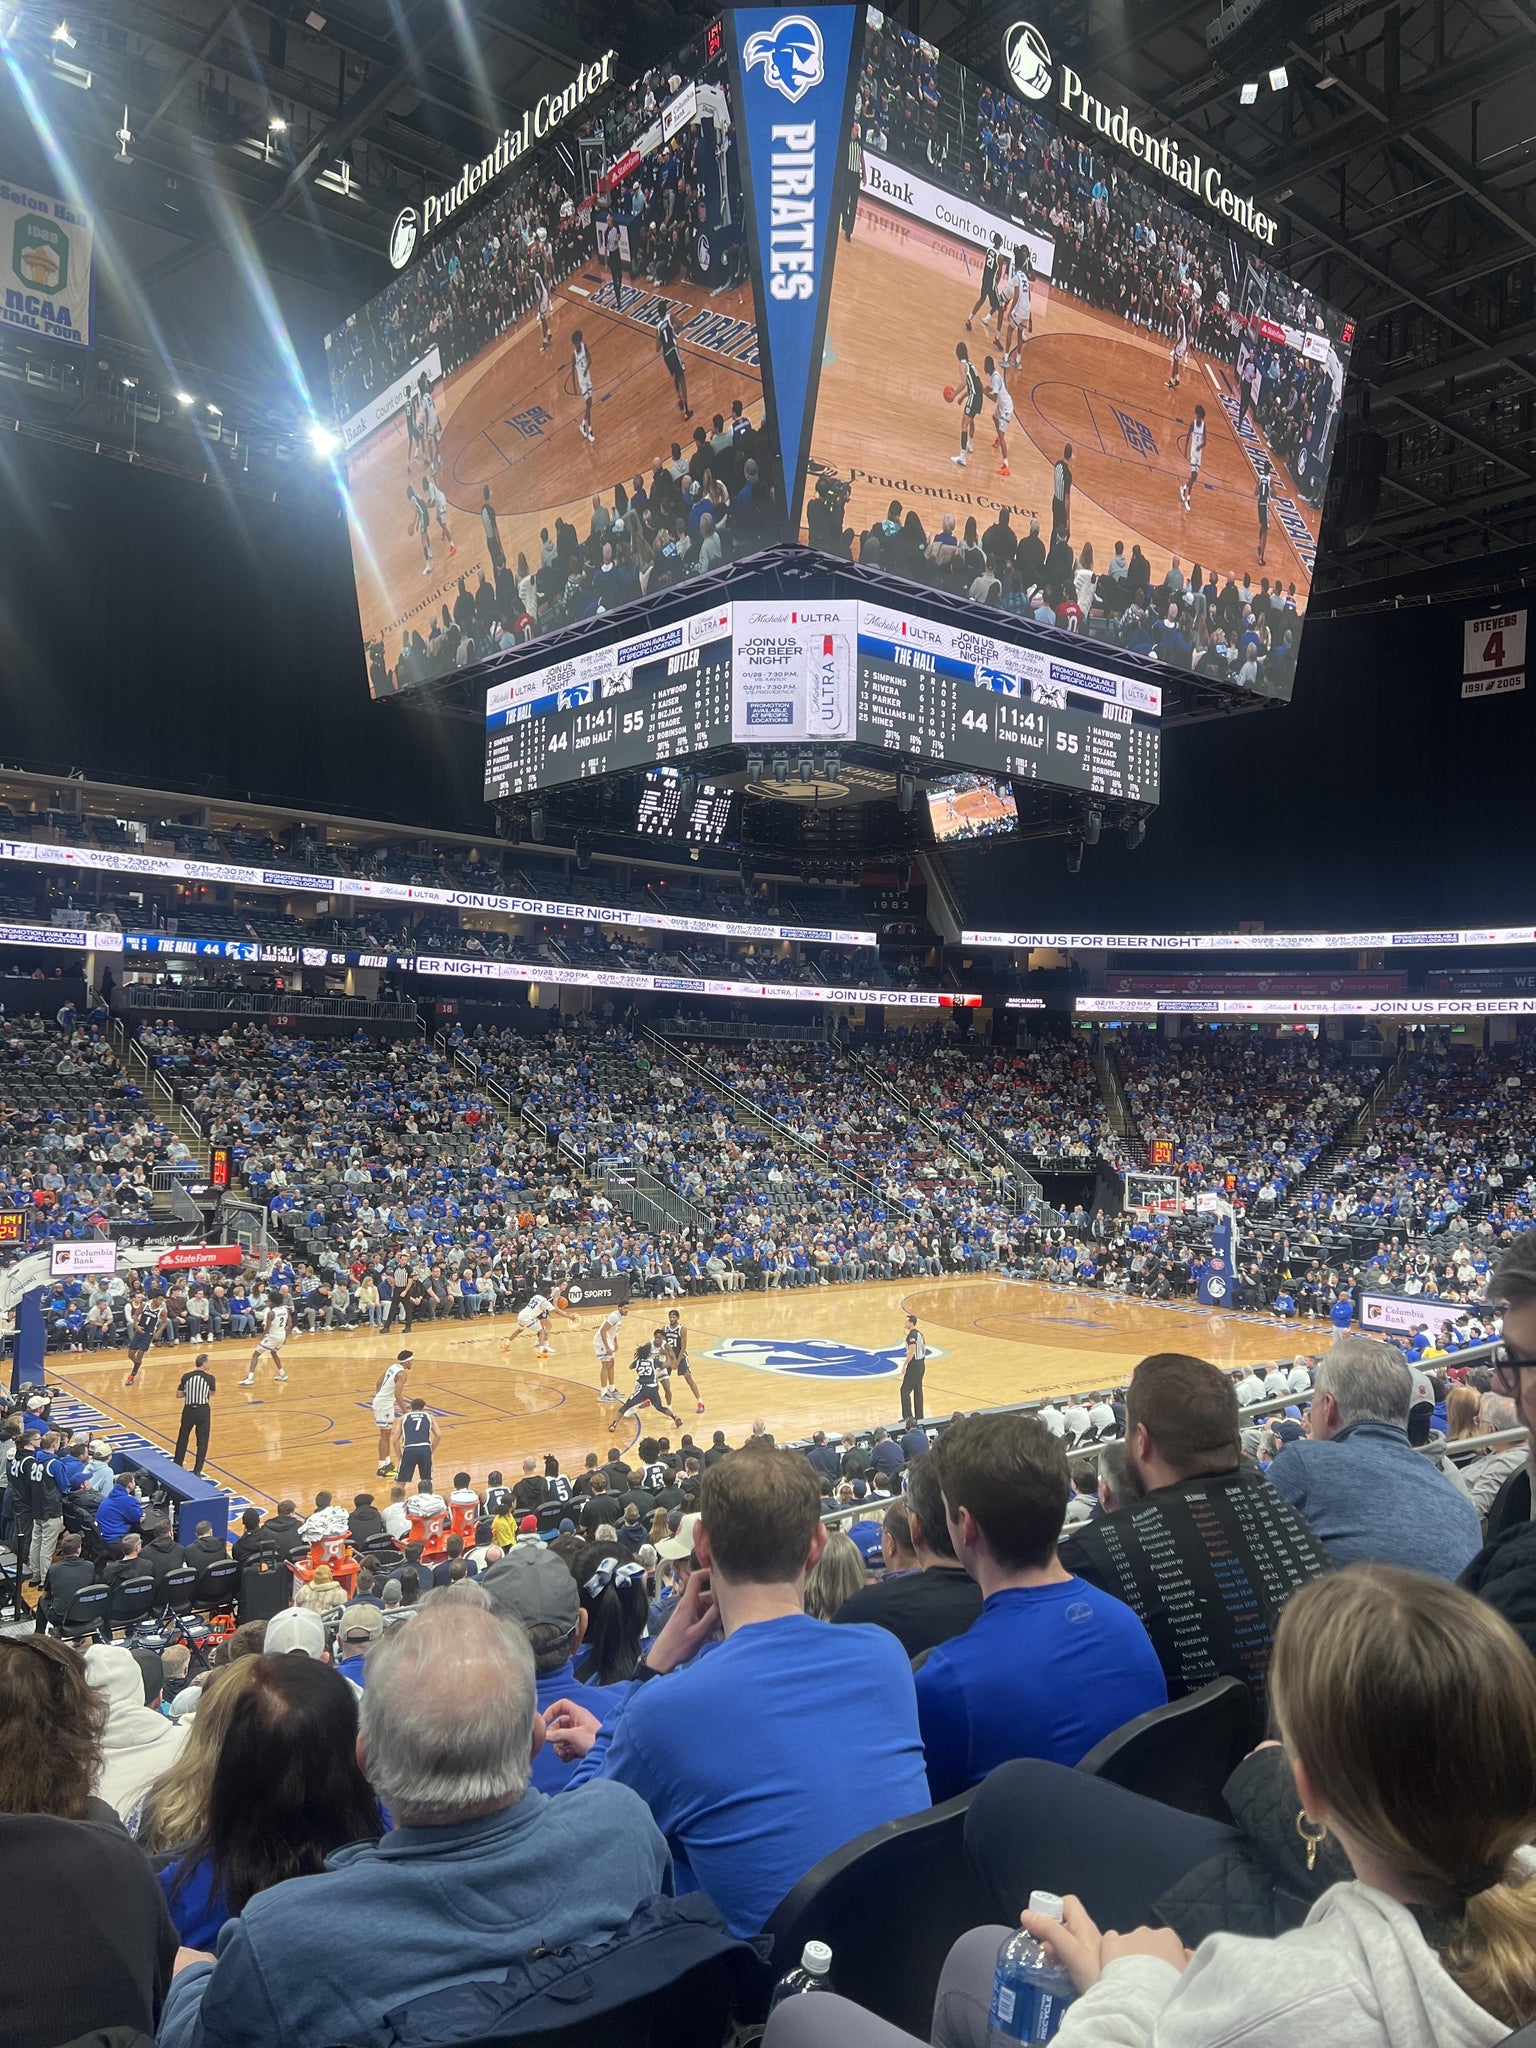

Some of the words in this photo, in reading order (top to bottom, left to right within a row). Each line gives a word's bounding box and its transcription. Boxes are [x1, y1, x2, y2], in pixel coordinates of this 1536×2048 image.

[423, 110, 529, 236] Prudential
[534, 49, 613, 138] Center
[1061, 65, 1200, 196] Prudential
[1206, 168, 1278, 246] Center
[870, 166, 914, 205] Bank
[935, 204, 971, 232] Count
[973, 225, 986, 239] on
[770, 120, 816, 300] PIRATES
[6, 288, 72, 327] NCAA
[44, 321, 82, 342] FOUR
[525, 406, 554, 425] BIG
[512, 414, 544, 438] EAST
[1118, 411, 1147, 459] EAST
[1134, 422, 1160, 455] BIG
[851, 468, 972, 504] Prudential
[380, 589, 441, 639] Prudential
[443, 562, 482, 591] Center
[749, 613, 788, 624] Michelob
[800, 614, 840, 622] ULTRA
[1473, 615, 1517, 632] STEVENS
[695, 620, 717, 635] ULTRA
[864, 613, 901, 632] Michelob
[910, 626, 941, 644] ULTRA
[619, 640, 650, 656] PROMOTION
[650, 630, 681, 646] AVAILABLE
[650, 638, 682, 653] LOCATIONS
[745, 638, 775, 646] JOIN
[778, 638, 796, 646] US
[957, 632, 979, 645] JOIN
[981, 639, 995, 649] US
[768, 647, 802, 655] BEER
[952, 639, 972, 651] FOR
[973, 646, 999, 660] BEER
[1483, 631, 1505, 668] 4
[668, 649, 700, 676] BUTLER
[750, 657, 791, 665] NIGHT
[894, 646, 912, 666] THE
[913, 651, 936, 673] HALL
[960, 651, 990, 666] NIGHT
[873, 672, 907, 687] SIMPKINS
[1052, 665, 1086, 680] PROMOTION
[1087, 673, 1115, 687] AVAILABLE
[515, 683, 536, 696] ULTRA
[658, 684, 687, 698] HAYWOOD
[822, 662, 834, 720] ULTRA
[873, 683, 899, 696] RIVERA
[1085, 680, 1115, 695] LOCATIONS
[1465, 683, 1483, 693] 1991
[1497, 676, 1520, 689] 2005
[872, 694, 901, 708] PARKER
[1128, 690, 1148, 700] ULTRA
[658, 697, 679, 709] KAISER
[658, 706, 683, 720] BIZJACK
[859, 702, 868, 711] 23
[872, 705, 906, 719] WILLIAMS
[1102, 702, 1133, 725] BUTLER
[576, 707, 612, 733] 11:41
[623, 710, 644, 734] 55
[658, 717, 680, 730] TRAORE
[859, 713, 868, 721] 25
[872, 716, 894, 728] HINES
[962, 709, 988, 733] 44
[1000, 706, 1044, 732] 11:41
[576, 735, 590, 750] 2ND
[592, 730, 612, 744] HALF
[657, 726, 686, 740] ROBINSON
[999, 729, 1018, 742] 2ND
[1020, 734, 1044, 748] HALF
[1093, 727, 1121, 741] HAYWOOD
[548, 731, 568, 752] 44
[1056, 731, 1078, 754] 55
[1093, 737, 1114, 748] KAISER
[884, 740, 900, 749] 27.3
[910, 746, 920, 754] 40
[931, 750, 944, 759] 71.4
[1093, 747, 1117, 758] BIZJACK
[1093, 756, 1115, 767] TRAORE
[1092, 766, 1120, 778] ROBINSON
[90, 853, 119, 863] 01/28
[127, 857, 149, 866] 7:30
[414, 891, 439, 899] ULTRA
[446, 893, 484, 906] JOIN
[487, 898, 508, 909] US
[512, 900, 542, 912] FOR
[546, 904, 584, 917] BEER
[587, 909, 631, 922] NIGHT
[158, 939, 177, 952] THE
[178, 940, 197, 954] HALL
[204, 944, 220, 955] 44
[1008, 936, 1044, 945] JOIN
[1046, 936, 1068, 945] US
[1071, 936, 1101, 946] FOR
[1106, 937, 1148, 946] BEER
[1151, 937, 1201, 947] NIGHT
[265, 946, 293, 955] 11:41
[278, 955, 296, 963] HALF
[331, 954, 346, 964] 55
[359, 954, 388, 967] BUTLER
[419, 960, 440, 972] ER
[444, 962, 493, 974] NIGHT
[827, 990, 857, 1000] JOIN
[859, 992, 877, 1001] US
[880, 993, 907, 1003] FOR
[910, 994, 939, 1004] BEE
[442, 1005, 452, 1013] 18
[1370, 1002, 1410, 1012] JOIN
[1412, 1002, 1435, 1011] US
[1439, 1002, 1471, 1011] FOR
[1476, 1002, 1514, 1012] BEER
[277, 1017, 288, 1025] 19
[74, 1249, 113, 1257] Columbia
[74, 1256, 94, 1264] Bank
[175, 1254, 216, 1264] StateFarm
[584, 1289, 612, 1298] SPORTS
[1386, 1306, 1424, 1318] Columbia
[1386, 1315, 1405, 1324] Bank
[667, 1339, 677, 1347] 21
[638, 1367, 652, 1376] 23
[412, 1418, 422, 1431] 7
[31, 1462, 43, 1481] 26
[651, 1475, 664, 1487] 13
[557, 1485, 568, 1500] 5
[1151, 1549, 1175, 1560] Newark
[1150, 1558, 1184, 1571] Piscataway
[1158, 1569, 1183, 1580] Newark
[1158, 1579, 1192, 1592] Piscataway
[1161, 1590, 1195, 1602] Piscataway
[1169, 1601, 1194, 1611] Newark
[1168, 1612, 1202, 1624] Piscataway
[1176, 1624, 1201, 1635] Newark
[1174, 1635, 1209, 1648] Piscataway
[1182, 1649, 1208, 1659] Newark
[1181, 1664, 1197, 1672] New
[1198, 1660, 1215, 1668] York
[1042, 1995, 1052, 2040] RECYCLE
